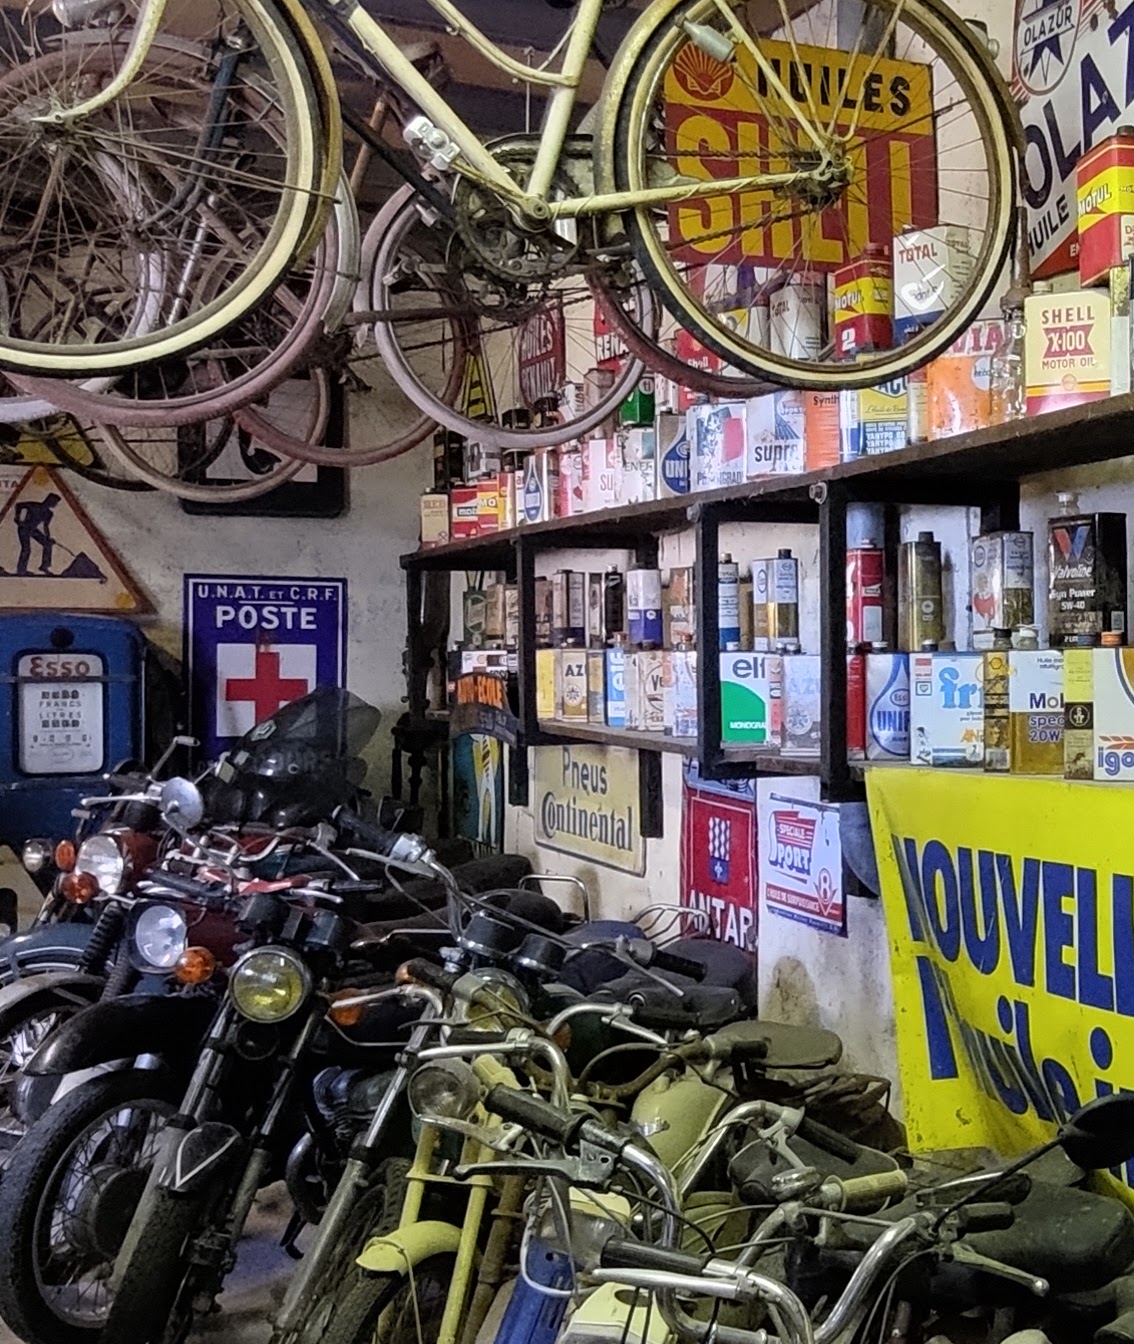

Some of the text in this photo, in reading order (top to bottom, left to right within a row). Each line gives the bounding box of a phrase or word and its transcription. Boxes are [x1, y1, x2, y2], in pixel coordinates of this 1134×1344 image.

[1023, 6, 1074, 47] OLAZUR
[757, 63, 912, 117] HUILES
[1078, 182, 1112, 215] MOTUL
[1042, 305, 1095, 325] SHELL
[1042, 358, 1076, 371] MOTOR
[198, 584, 338, 602] U.N.A.T. ET C.R.F.
[216, 606, 318, 630] POSTE
[562, 746, 608, 795] Pneus
[541, 791, 634, 853] Continental
